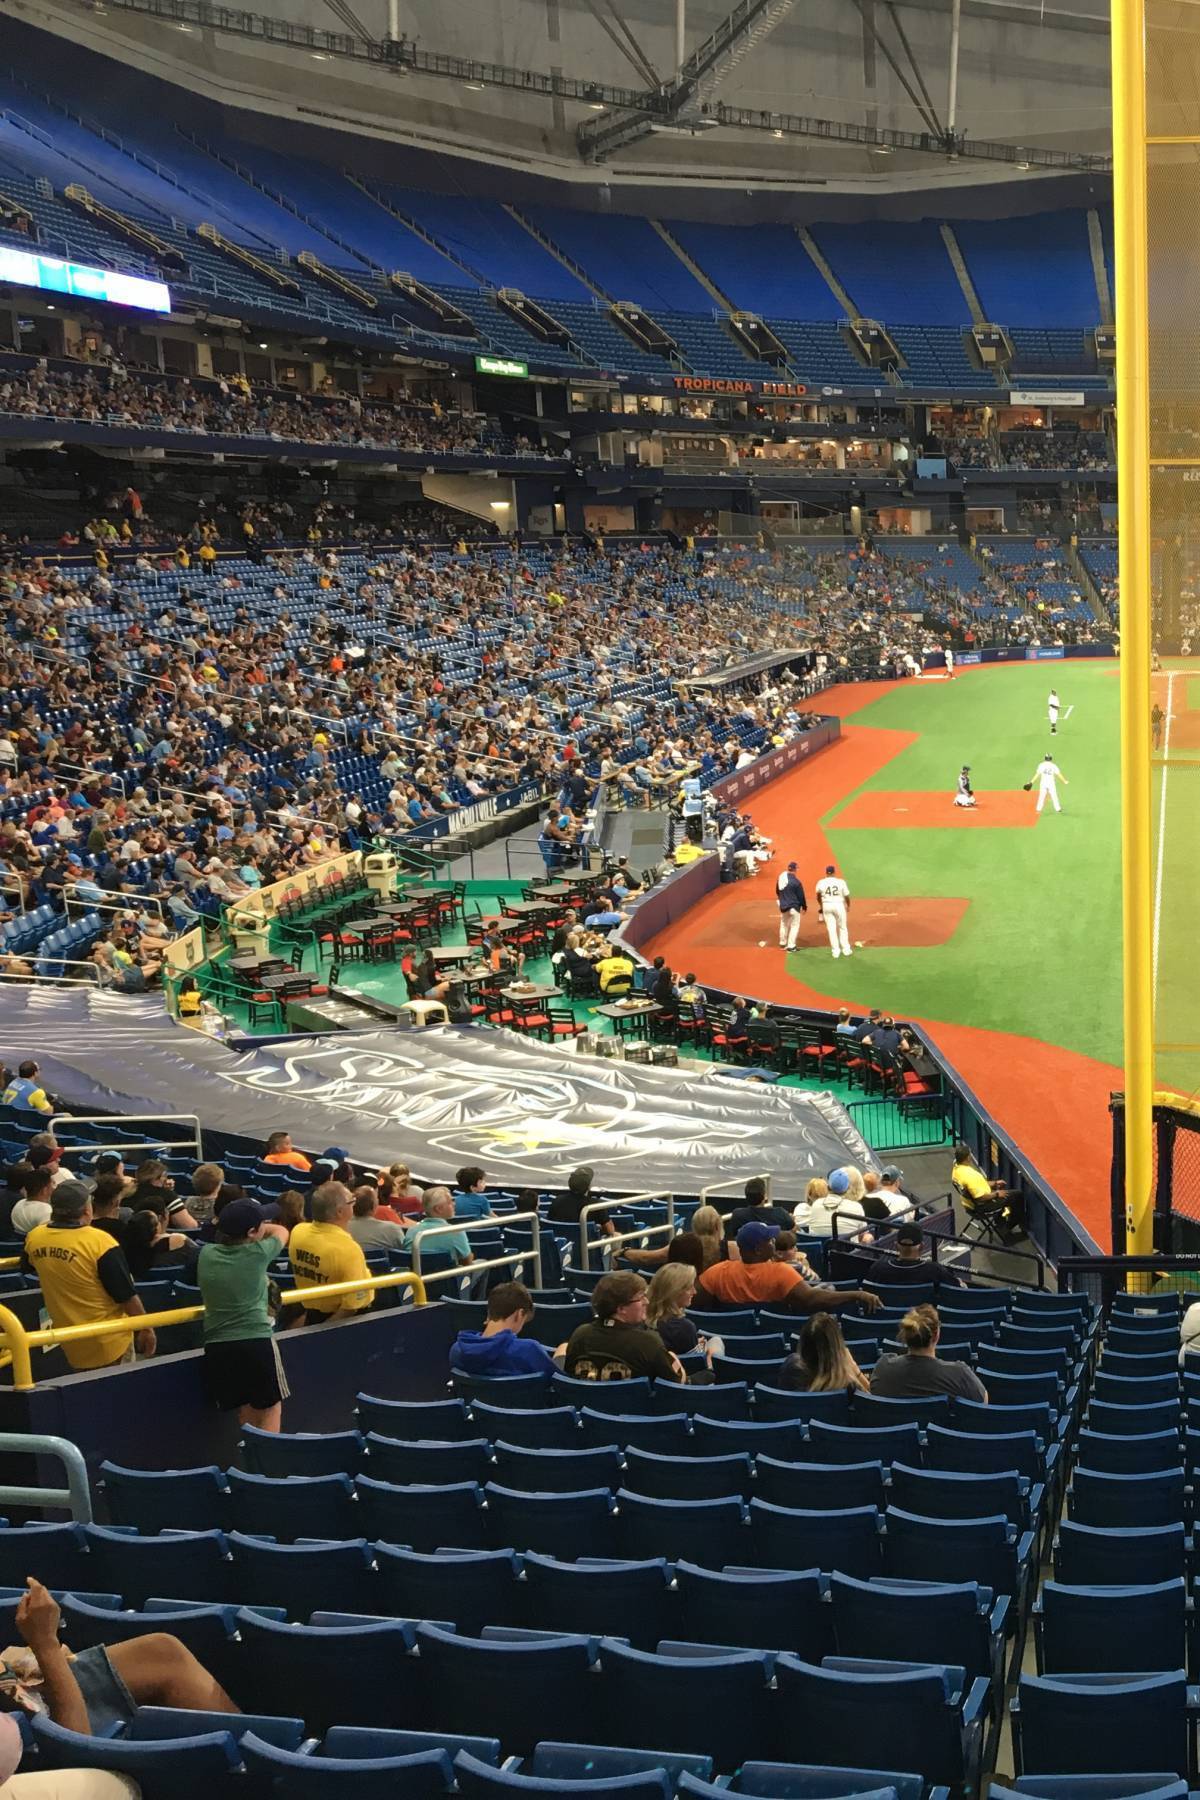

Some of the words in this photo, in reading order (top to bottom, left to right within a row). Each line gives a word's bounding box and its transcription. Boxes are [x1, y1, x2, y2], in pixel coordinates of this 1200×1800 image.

[673, 377, 753, 393] TROPICANA
[762, 382, 806, 396] FIELD
[825, 886, 840, 896] 42
[49, 1246, 77, 1263] HOST
